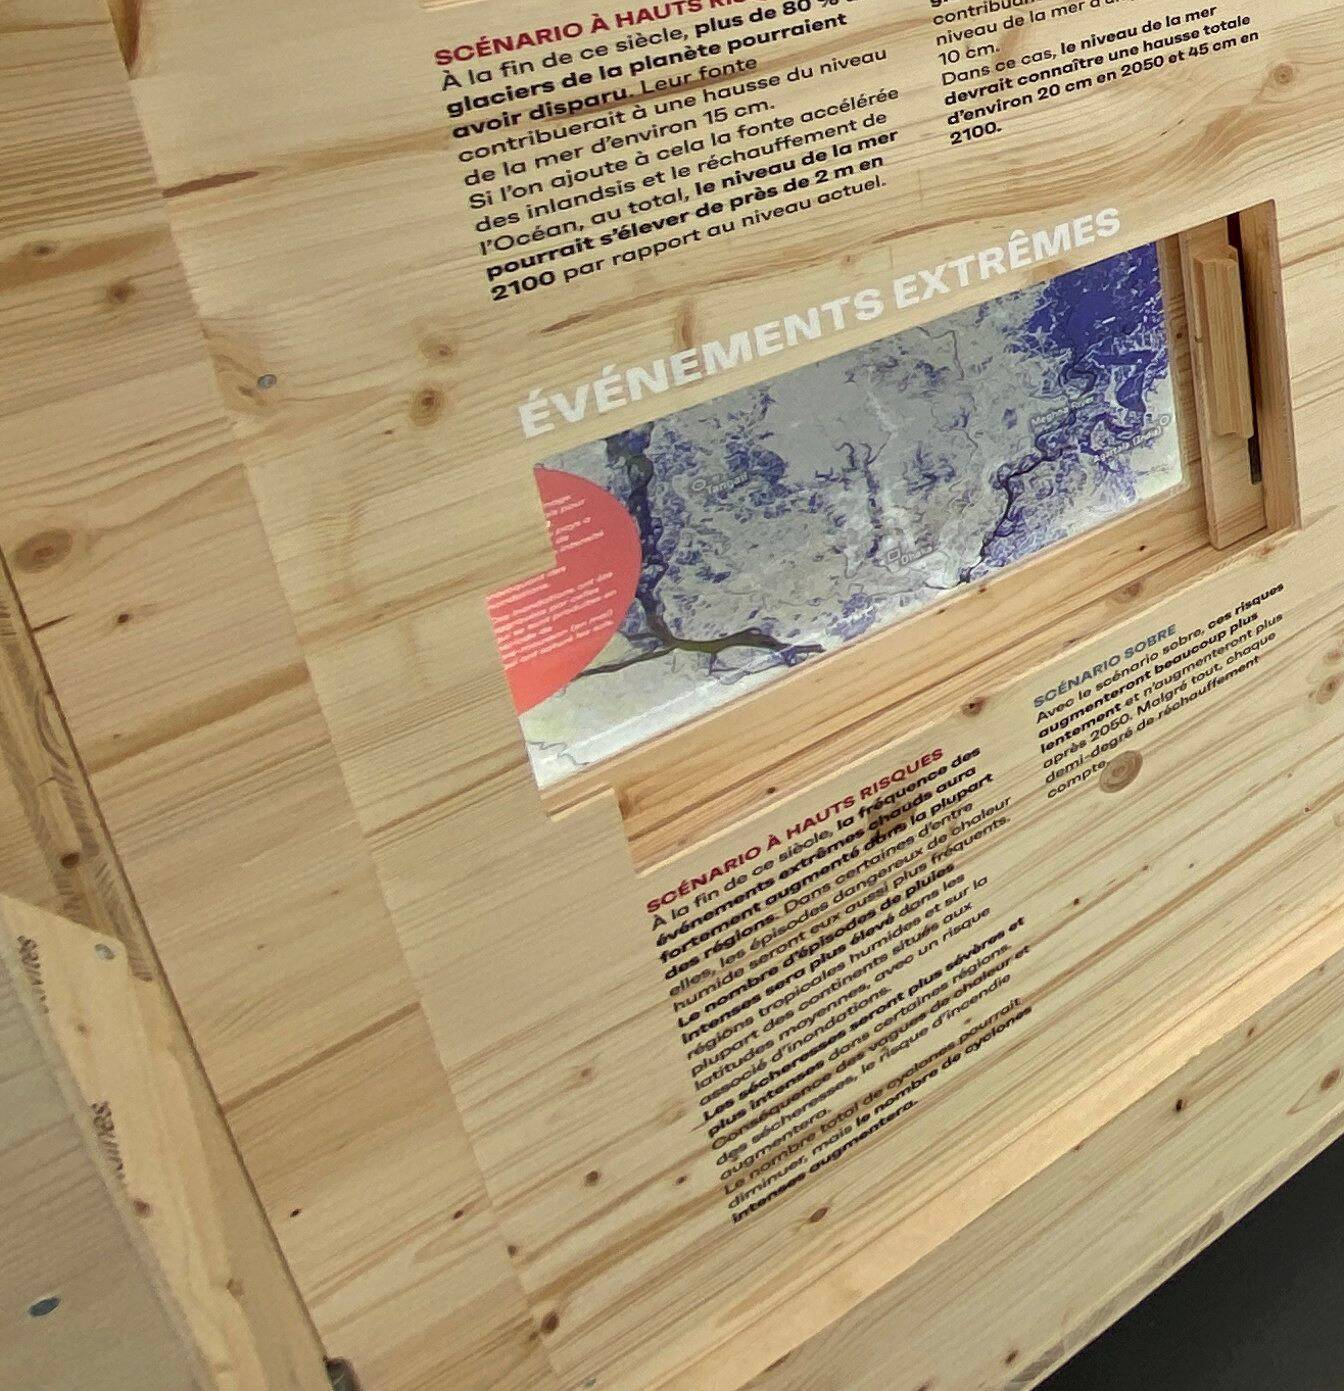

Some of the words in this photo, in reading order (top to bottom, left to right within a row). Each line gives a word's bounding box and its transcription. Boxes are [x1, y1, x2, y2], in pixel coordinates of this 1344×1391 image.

[433, 22, 584, 66] SCÉNARIO
[590, 12, 611, 34] À
[441, 69, 463, 92] À
[467, 69, 493, 86] la
[498, 59, 535, 78] fin
[541, 51, 574, 69] de
[579, 44, 609, 60] ce
[615, 27, 689, 53] siècle,
[694, 15, 744, 39] plus
[748, 6, 777, 23] de
[446, 80, 556, 119] glaciers
[561, 71, 593, 89] de
[598, 65, 623, 81] la
[628, 43, 722, 77] planète
[726, 13, 848, 55] pourraient
[452, 111, 522, 139] avoir
[528, 85, 634, 122] disparu.
[640, 73, 693, 97] Leur
[698, 57, 758, 82] fonte
[517, 288, 884, 440] ÉVÉNEMENTS
[893, 208, 1122, 310] EXTRÊMES
[1033, 654, 1121, 708] SCÉNARIO
[1124, 623, 1176, 659] SOBRE
[646, 846, 762, 914] SCÉNARIO
[766, 833, 782, 852] À
[785, 795, 856, 840] HAUTS
[859, 747, 945, 801] RISQUES
